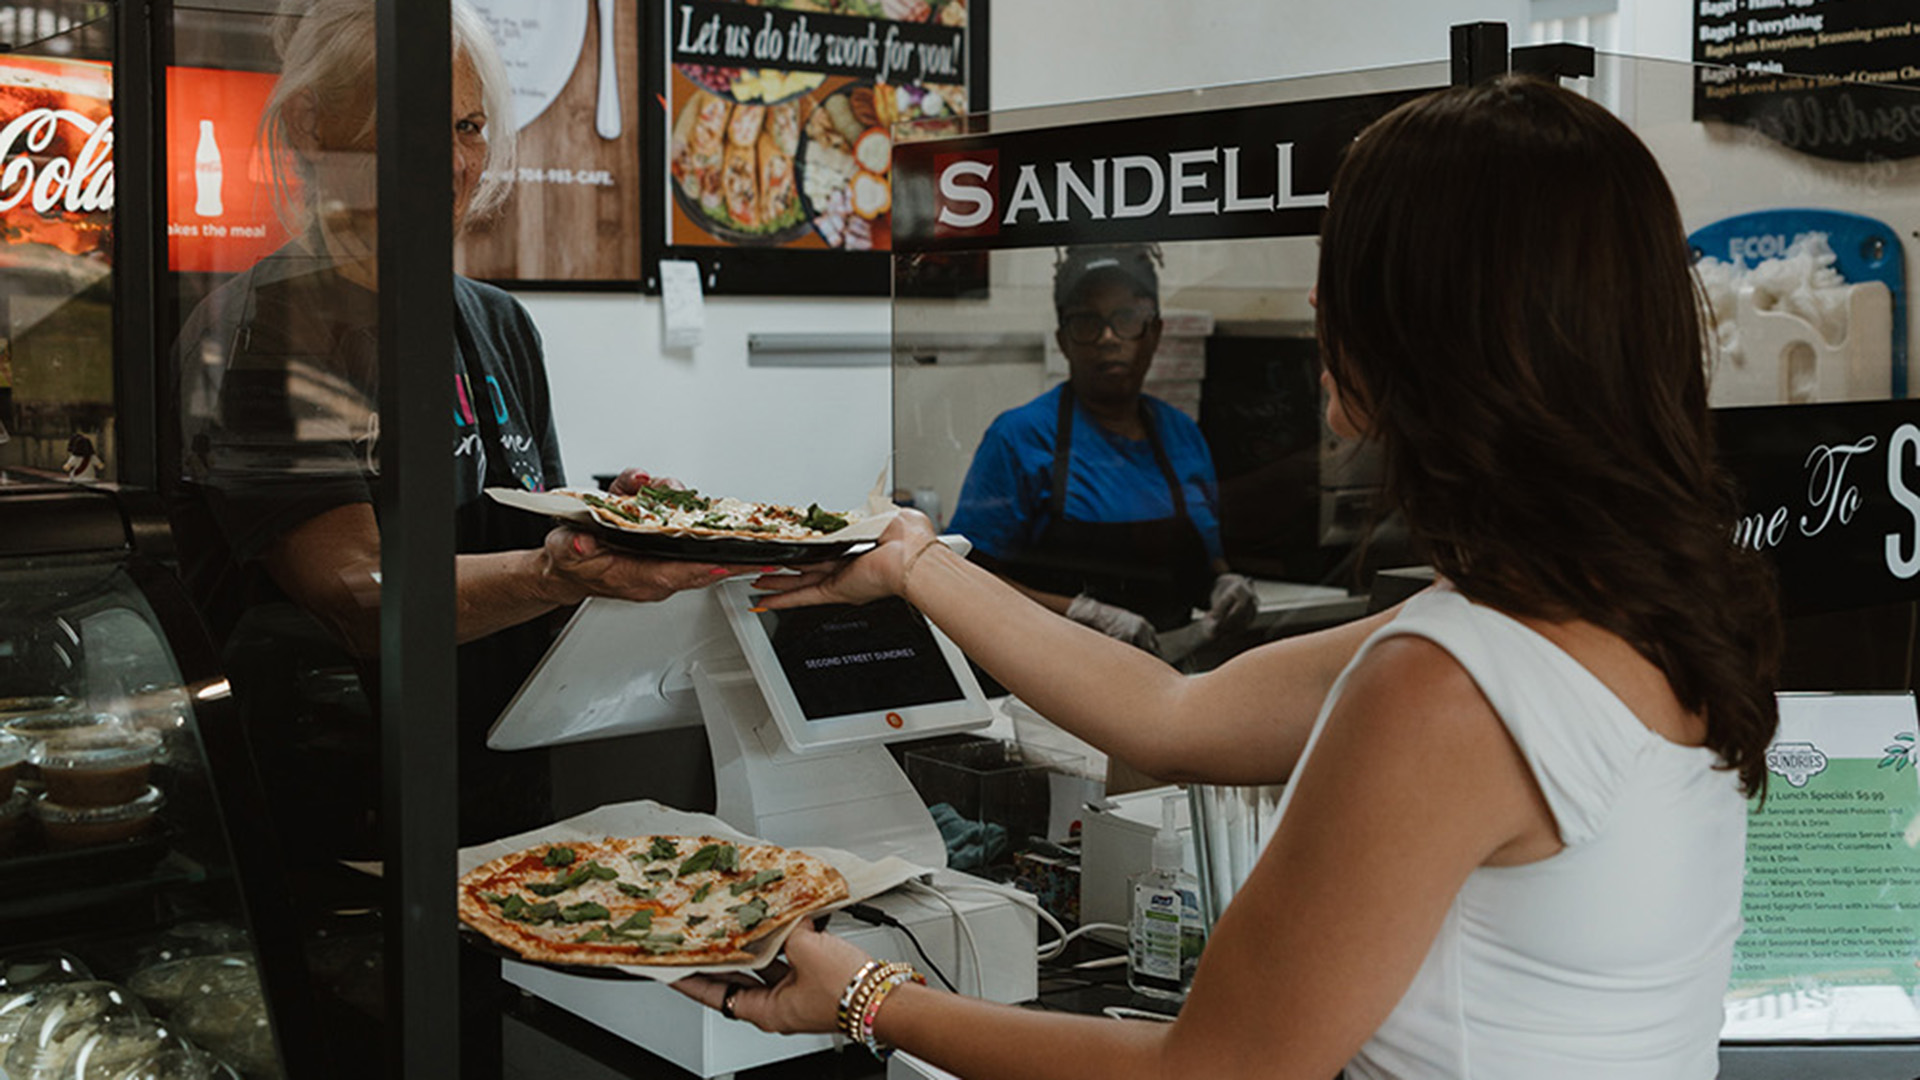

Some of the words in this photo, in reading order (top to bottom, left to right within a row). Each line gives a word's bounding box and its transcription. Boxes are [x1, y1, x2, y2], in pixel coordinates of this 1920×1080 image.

[1700, 21, 1737, 43] Bagel
[1747, 13, 1824, 36] Everything
[1759, 33, 1816, 51] Everything
[1818, 26, 1873, 43] Seasoning
[676, 5, 721, 54] Let
[724, 23, 751, 58] us
[754, 11, 784, 61] do
[787, 15, 821, 64] the
[824, 22, 879, 69] work
[875, 24, 915, 85] for
[912, 33, 962, 87] you!
[1858, 69, 1898, 83] Cream
[0, 107, 114, 213] Cola
[938, 141, 1330, 228] SANDELL
[203, 224, 227, 237] the
[230, 225, 266, 238] meal
[1800, 435, 1878, 537] To
[804, 656, 841, 669] SECOND
[842, 652, 874, 665] STREET
[874, 648, 916, 661] SUNDRIES
[1776, 791, 1808, 801] Lunch
[1810, 790, 1854, 802] Specials
[1778, 855, 1800, 863] Drink
[1804, 890, 1825, 899] Drink
